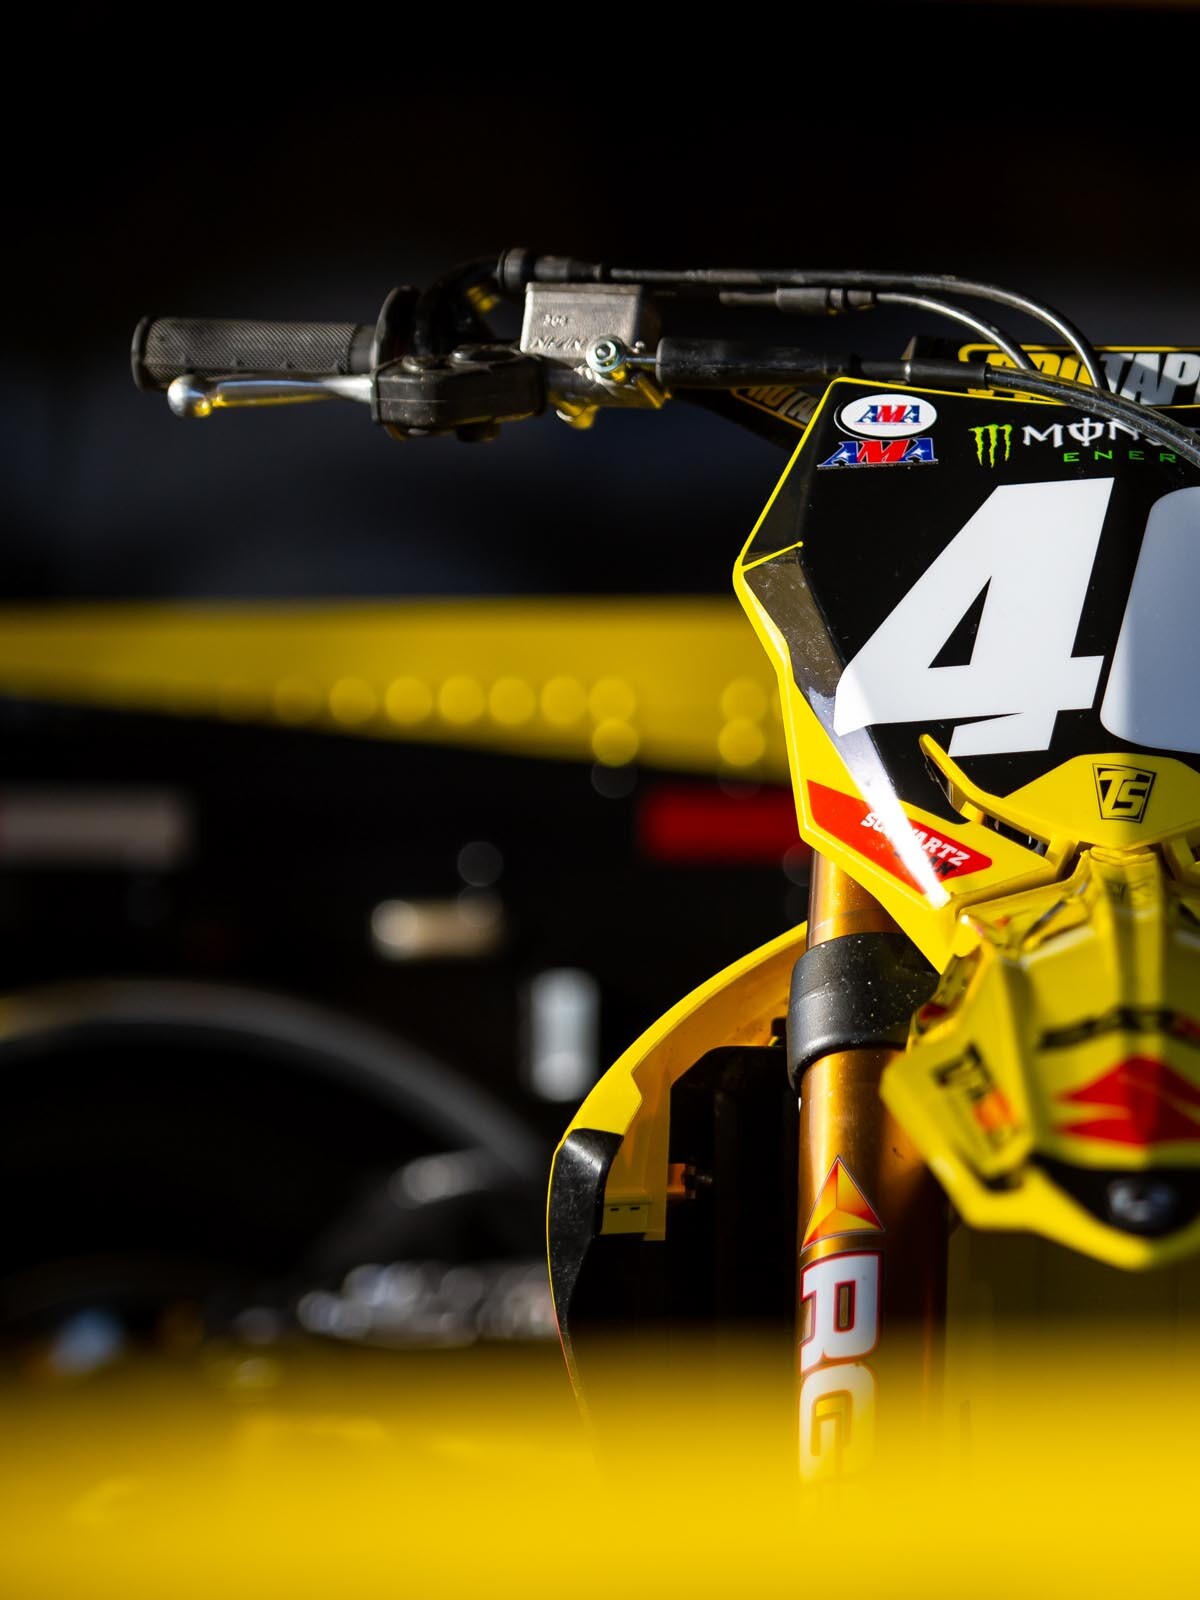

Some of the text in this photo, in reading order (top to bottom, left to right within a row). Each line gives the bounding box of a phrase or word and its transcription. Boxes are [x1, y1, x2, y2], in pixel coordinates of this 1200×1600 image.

[856, 405, 921, 423] AMA
[817, 437, 938, 468] AMA
[1097, 768, 1151, 819] TS
